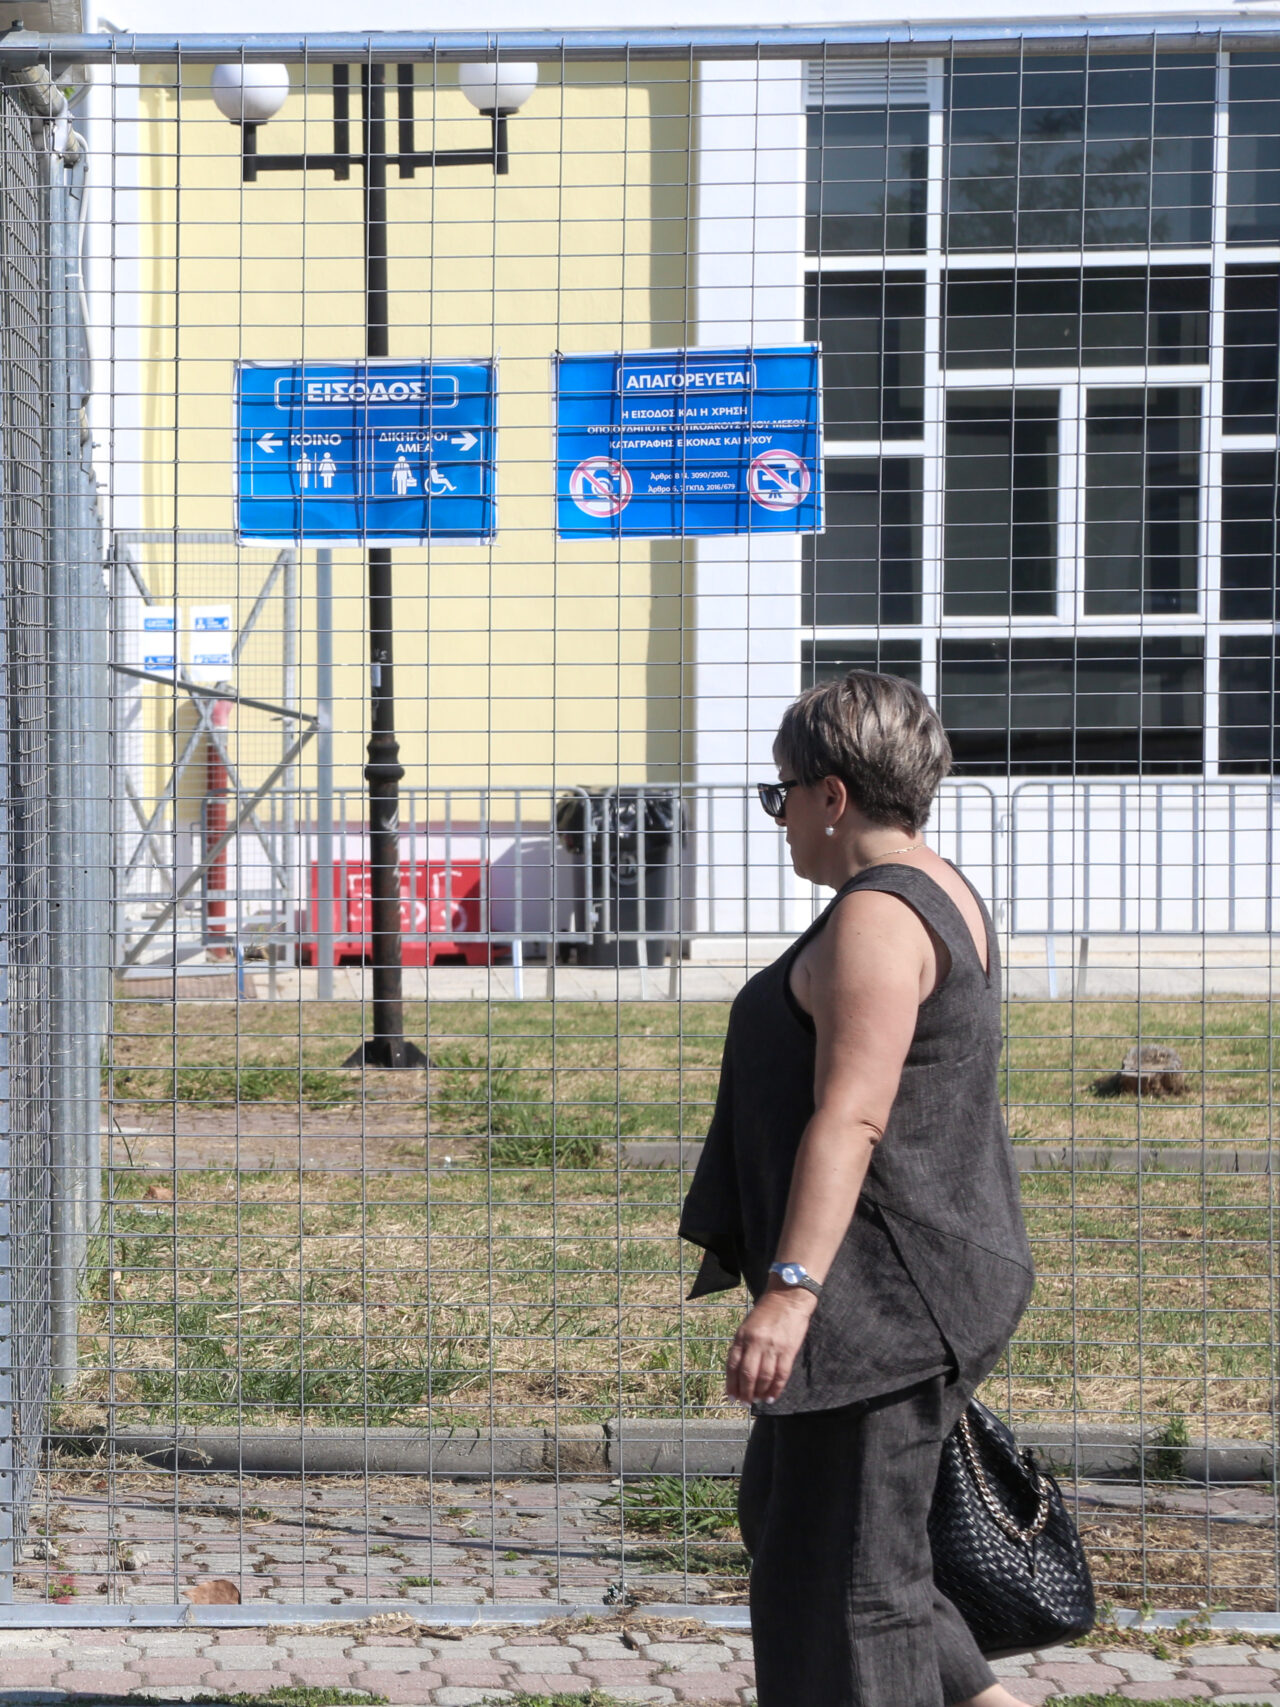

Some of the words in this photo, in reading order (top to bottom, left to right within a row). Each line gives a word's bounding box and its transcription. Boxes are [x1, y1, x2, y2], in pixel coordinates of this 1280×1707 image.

[626, 371, 750, 389] ΑΠΑΓΟΡΕΥΕΤΑΙ
[307, 382, 427, 402] ΕΙΣΟΔΟΣ
[631, 408, 675, 419] ΕΙΣΟΔΟΣ
[678, 407, 697, 417] ΚΑΙ
[700, 407, 708, 417] Η
[711, 406, 748, 416] ΧΡΗΣΗ
[290, 433, 342, 446] ΚΟΙΝΟ
[379, 431, 448, 442] ΔΙΚΗΓΟΡΟΙ
[609, 439, 674, 449] ΚΑΤΑΓΡΑΦΗΣ
[677, 437, 721, 447] ΕΚΟΝΑΣ
[724, 436, 741, 446] ΚΑΙ
[743, 435, 773, 445] ΗΧΟΥ
[395, 443, 434, 453] ΑΜΕΑ
[650, 472, 672, 481] Άρθρο
[691, 471, 730, 480] 3090/2002,
[648, 484, 671, 493] Άρθρο
[706, 483, 736, 491] 2016/679
